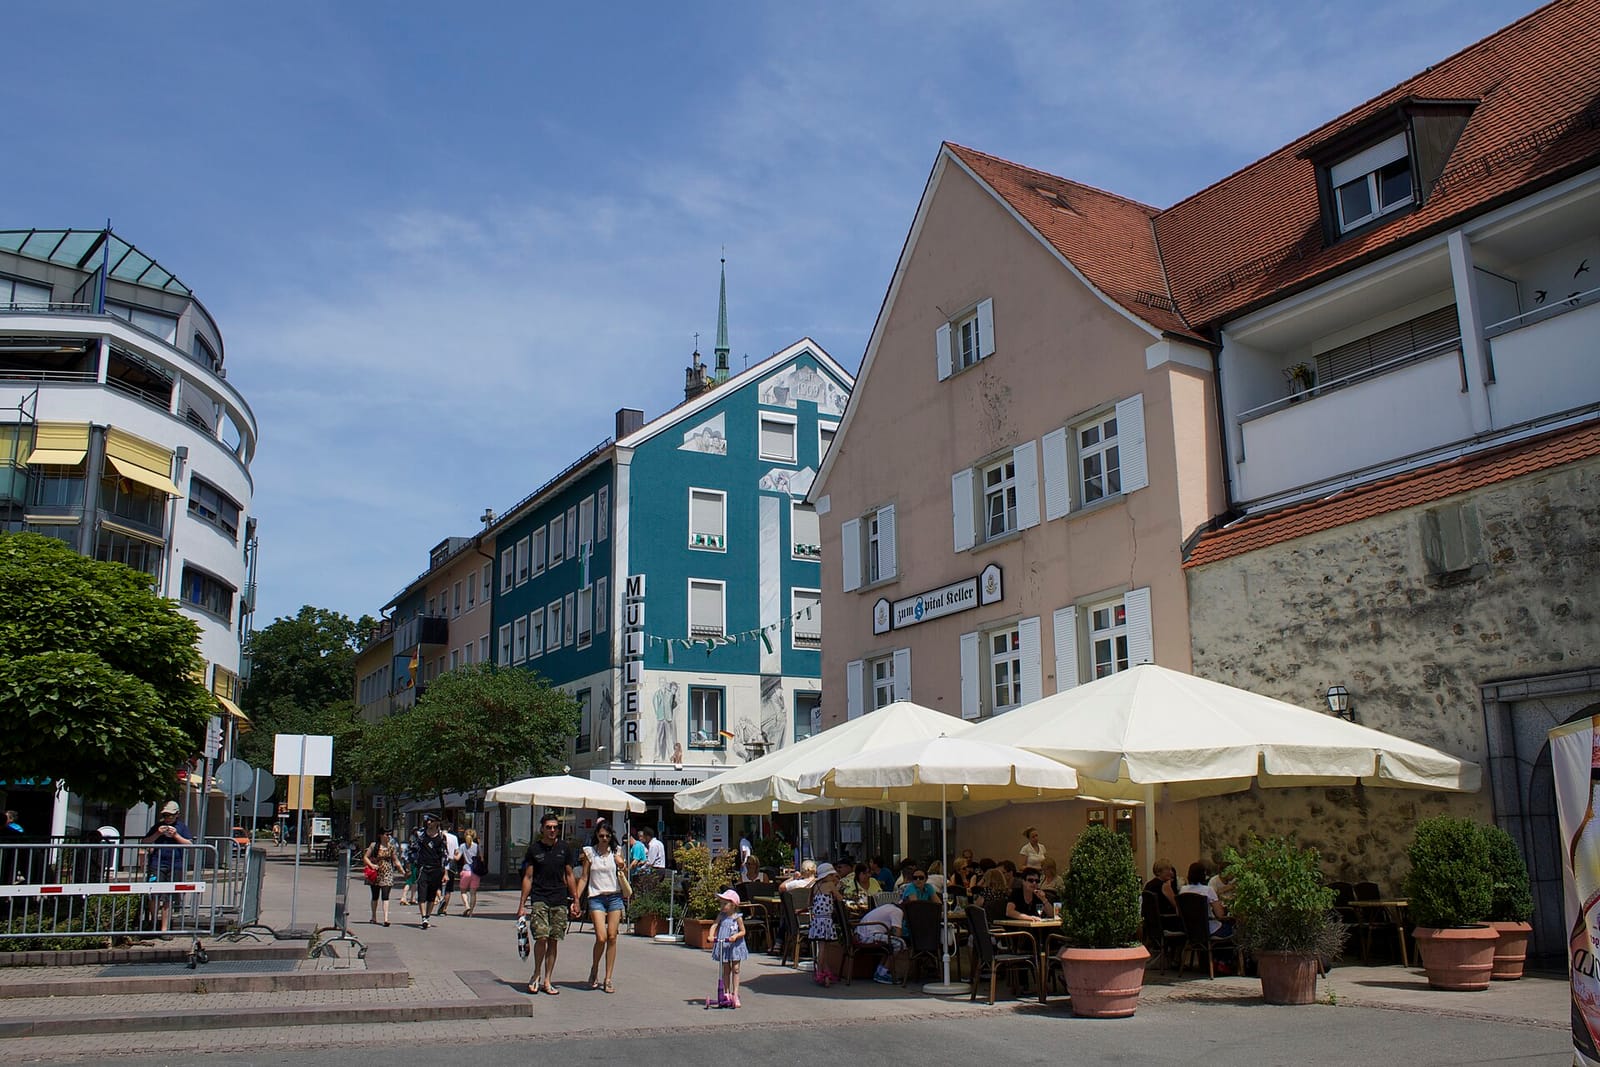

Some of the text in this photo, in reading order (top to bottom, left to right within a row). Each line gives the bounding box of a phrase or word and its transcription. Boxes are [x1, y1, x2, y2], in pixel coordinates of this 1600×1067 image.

[946, 587, 974, 605] Keller
[626, 576, 641, 742] MÜLLER
[611, 777, 625, 786] Der
